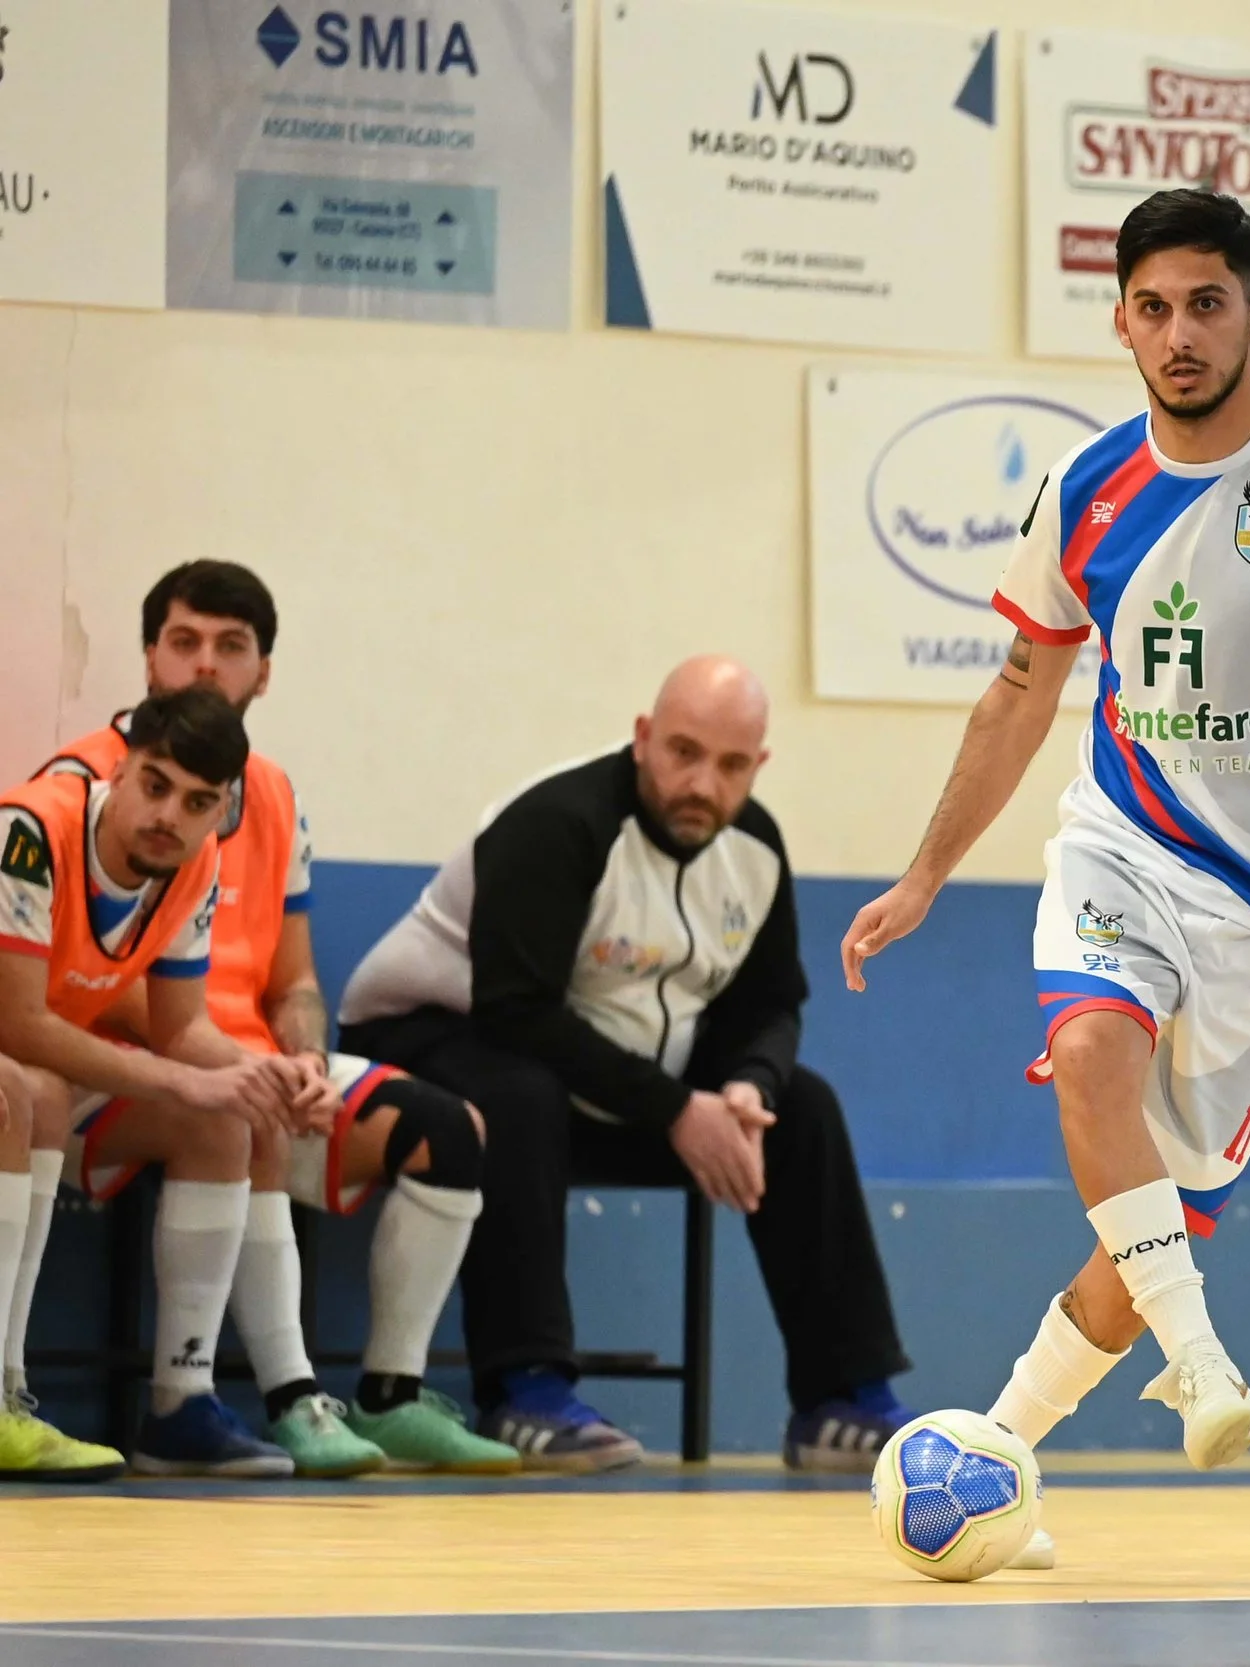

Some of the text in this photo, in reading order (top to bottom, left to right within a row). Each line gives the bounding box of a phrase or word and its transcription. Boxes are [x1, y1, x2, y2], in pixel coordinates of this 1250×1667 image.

[313, 11, 479, 77] SMIA
[751, 49, 856, 125] MD
[689, 130, 917, 172] MARIO D'AQUINO
[1091, 501, 1116, 512] ON
[1091, 511, 1113, 524] ZE
[903, 637, 1009, 670] VIAGRA
[1160, 758, 1201, 775] EEN
